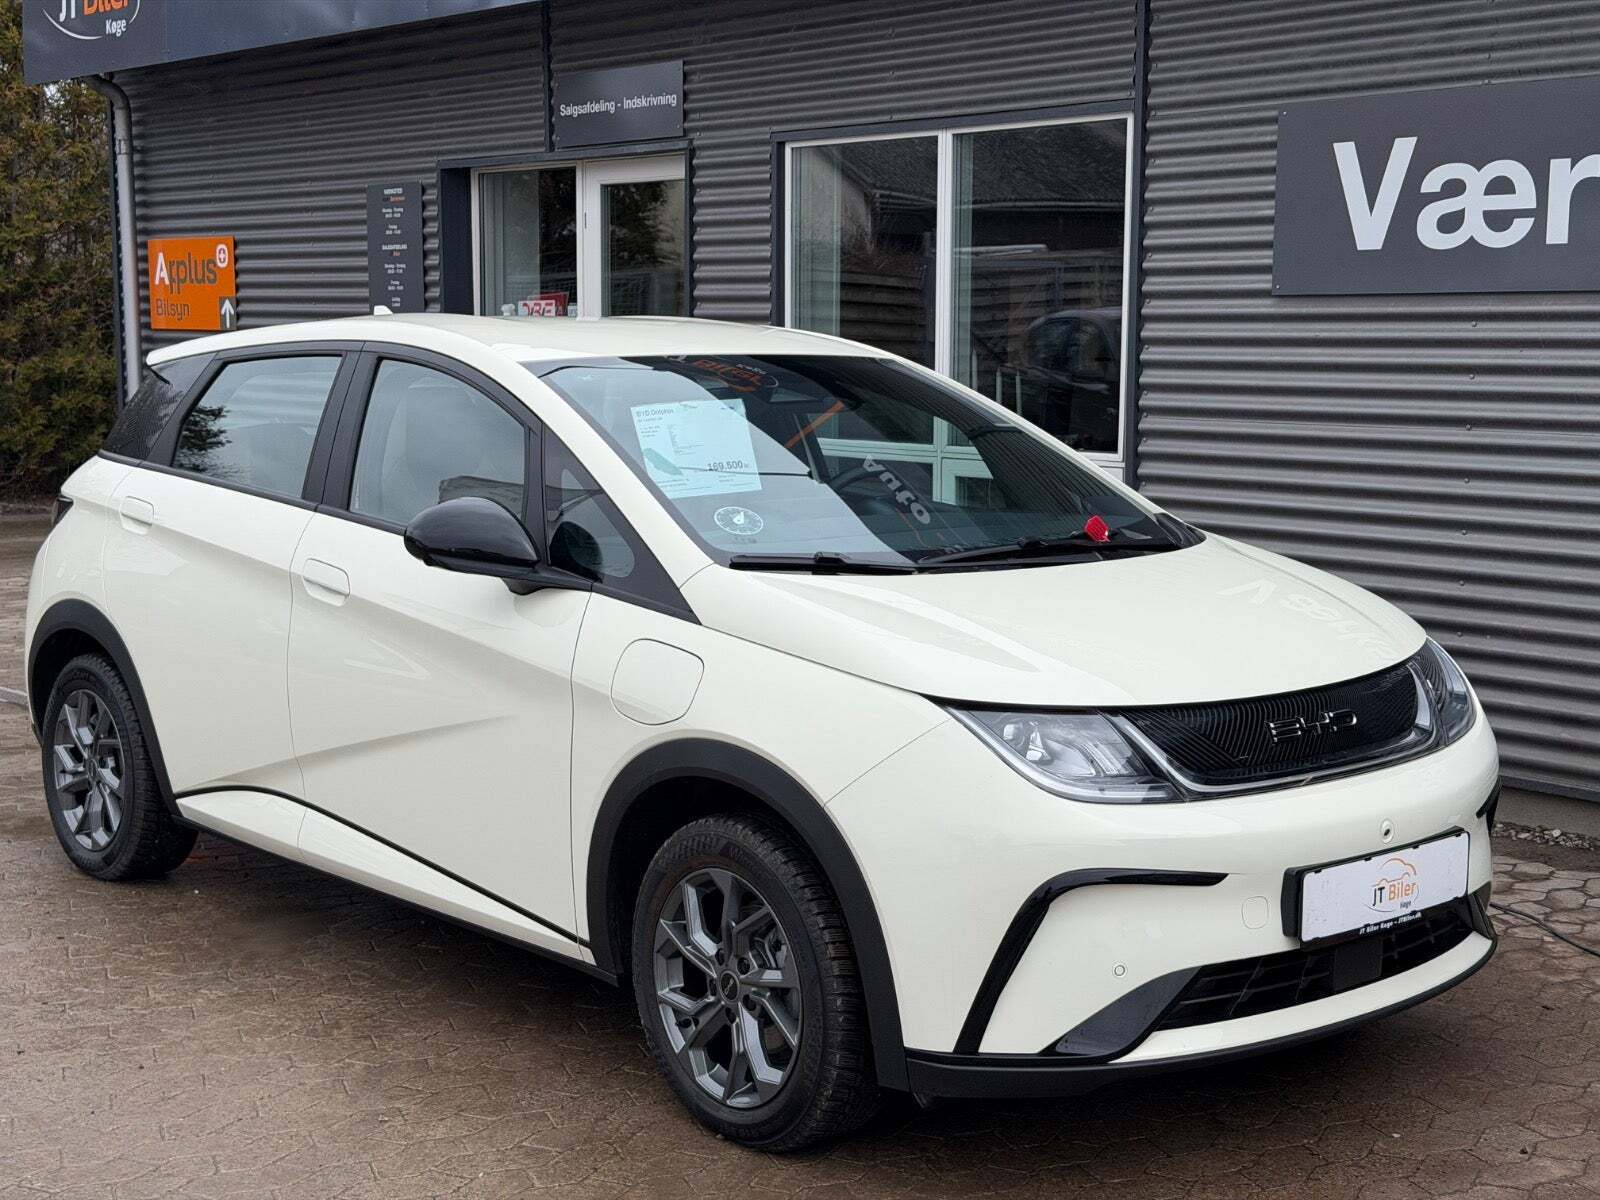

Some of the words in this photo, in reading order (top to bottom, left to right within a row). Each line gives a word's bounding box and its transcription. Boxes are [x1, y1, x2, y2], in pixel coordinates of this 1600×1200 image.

[105, 19, 127, 37] Køge
[559, 99, 616, 117] Salgsafdeling
[623, 92, 677, 109] Indskrivning
[156, 298, 190, 320] Bilsyn
[1372, 886, 1385, 906] JT
[1388, 881, 1416, 901] Biler
